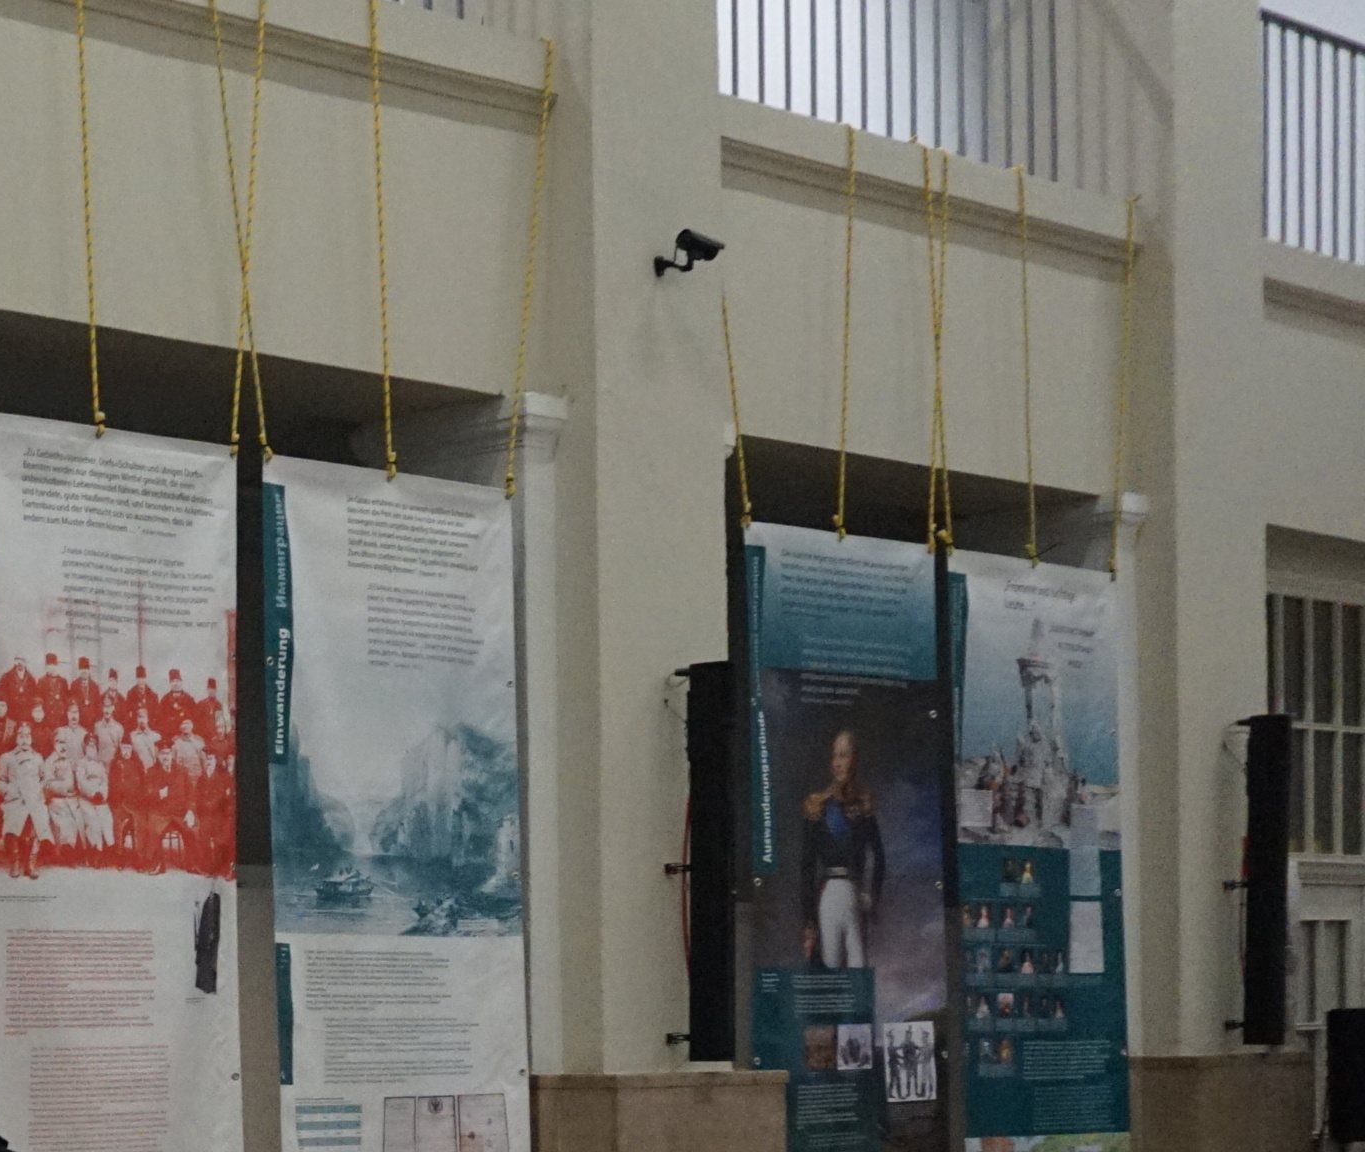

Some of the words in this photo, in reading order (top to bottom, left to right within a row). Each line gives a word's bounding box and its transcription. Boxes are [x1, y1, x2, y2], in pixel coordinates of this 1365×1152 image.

[275, 494, 287, 608] Иммиграция
[275, 628, 291, 755] Einwanderung
[756, 710, 772, 863] Auswanderungsgründe
